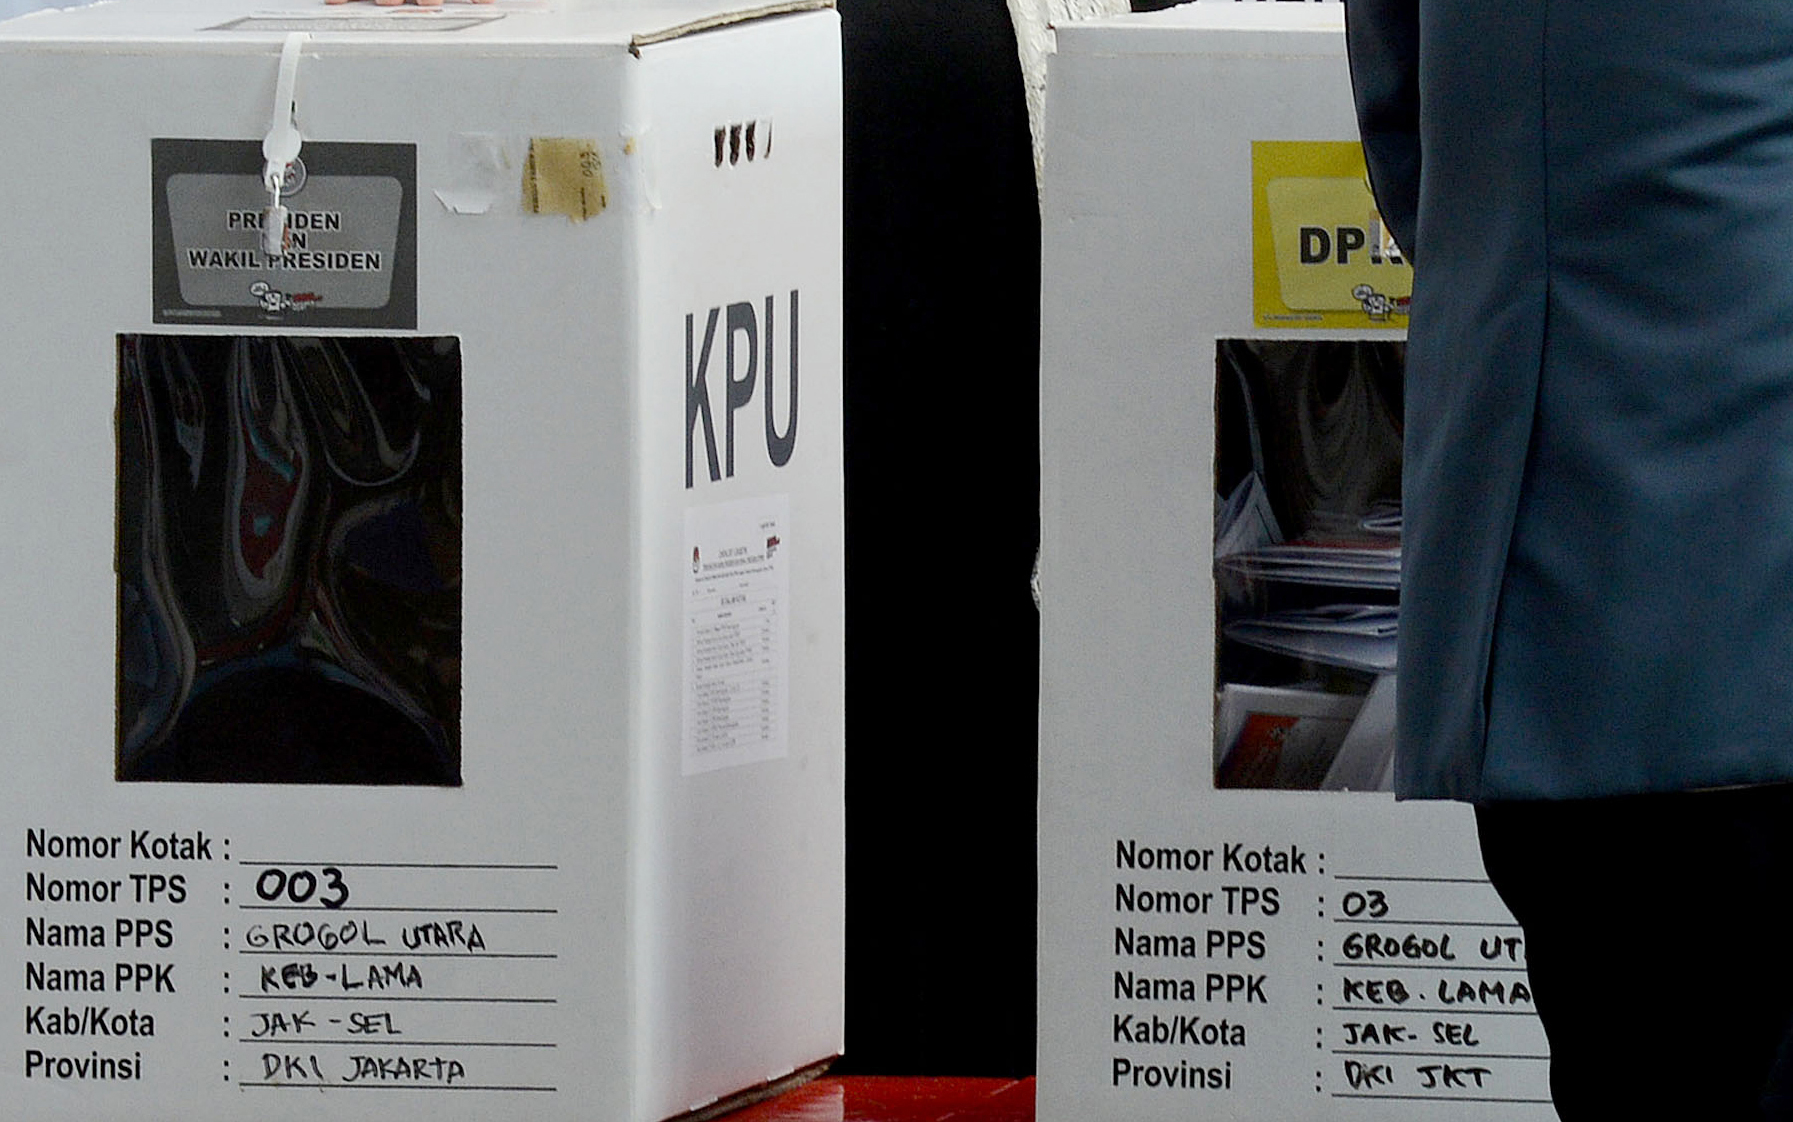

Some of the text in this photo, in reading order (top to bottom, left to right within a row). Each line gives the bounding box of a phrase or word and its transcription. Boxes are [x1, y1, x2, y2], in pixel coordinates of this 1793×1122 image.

[228, 212, 340, 229] PRIDEN
[188, 250, 382, 271] WAKIL PRESIDEN
[1299, 226, 1404, 265] DP
[685, 289, 799, 489] KPU
[27, 828, 212, 860] Nomor Kotak
[1117, 840, 1306, 874] Nomor Kotak
[27, 872, 186, 903] Nomor TPS
[256, 868, 349, 909] 003
[1116, 883, 1280, 916] Nomor TPS
[1343, 891, 1389, 918] 03
[27, 917, 172, 948] Nama PPS
[246, 920, 486, 952] GROGOL UTARA
[1115, 927, 1265, 959] Nama PPS
[1342, 933, 1523, 962] GROGOL UT
[27, 962, 175, 993] Nama PPK
[1115, 971, 1267, 1003] Nama PPK
[1438, 980, 1530, 1004] LAMA
[26, 1006, 154, 1036] Kab/Kota
[1114, 1014, 1245, 1046] Kab/Kota
[26, 1050, 140, 1080] Provinsi
[342, 1054, 465, 1083] JAKARTA
[1113, 1057, 1231, 1089] Provinsi
[1344, 1060, 1491, 1089] DKI JKT
